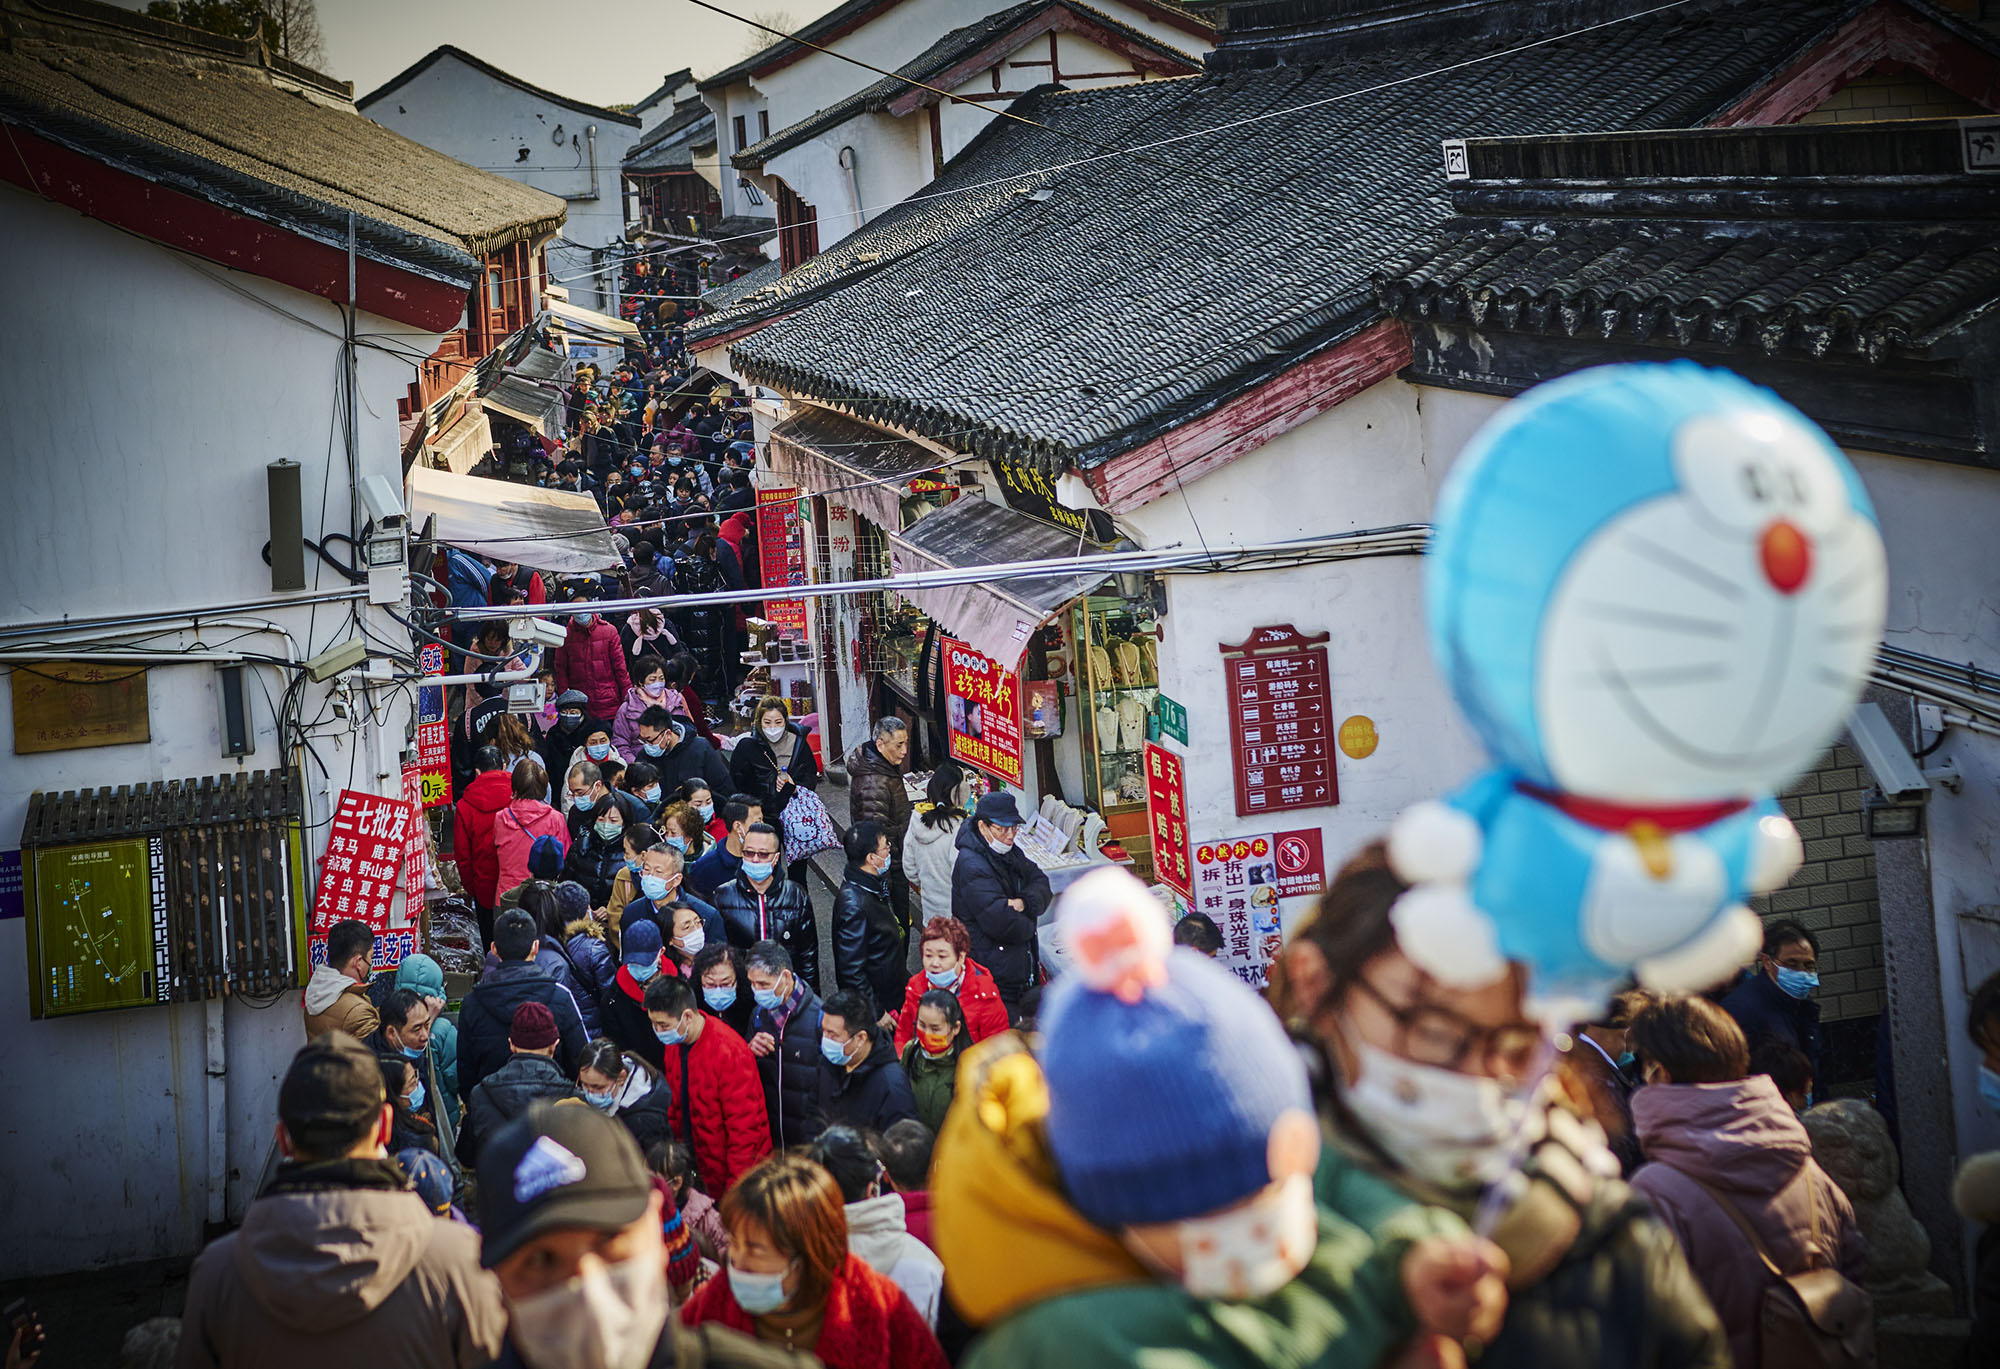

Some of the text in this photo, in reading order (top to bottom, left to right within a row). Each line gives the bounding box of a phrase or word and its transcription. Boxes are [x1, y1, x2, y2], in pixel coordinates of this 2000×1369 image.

[421, 647, 443, 672] 芝麻
[952, 651, 988, 674] 天然珍珠
[1268, 680, 1299, 691] 游船码头
[417, 725, 446, 747] 斤黑芝麻
[955, 733, 990, 763] 诚招批发代理
[335, 797, 409, 843] 三七批发
[1151, 751, 1171, 869] 假一赔十
[1167, 760, 1187, 883] 天然珍珠
[331, 836, 358, 855] 海马
[371, 844, 400, 863] 鹿茸
[1199, 840, 1268, 862] 天然珍珠
[326, 855, 395, 881] 燕窝 野山参
[1277, 873, 1320, 887] 勿随地吐痰
[323, 874, 391, 899] 冬虫夏草
[1286, 883, 1321, 895] SPITTING
[318, 893, 386, 918] 大连海参
[1224, 860, 1251, 960] 拆出一身珠光宝气
[314, 911, 382, 931] 灵芝油
[371, 931, 414, 967] 黑芝麻
